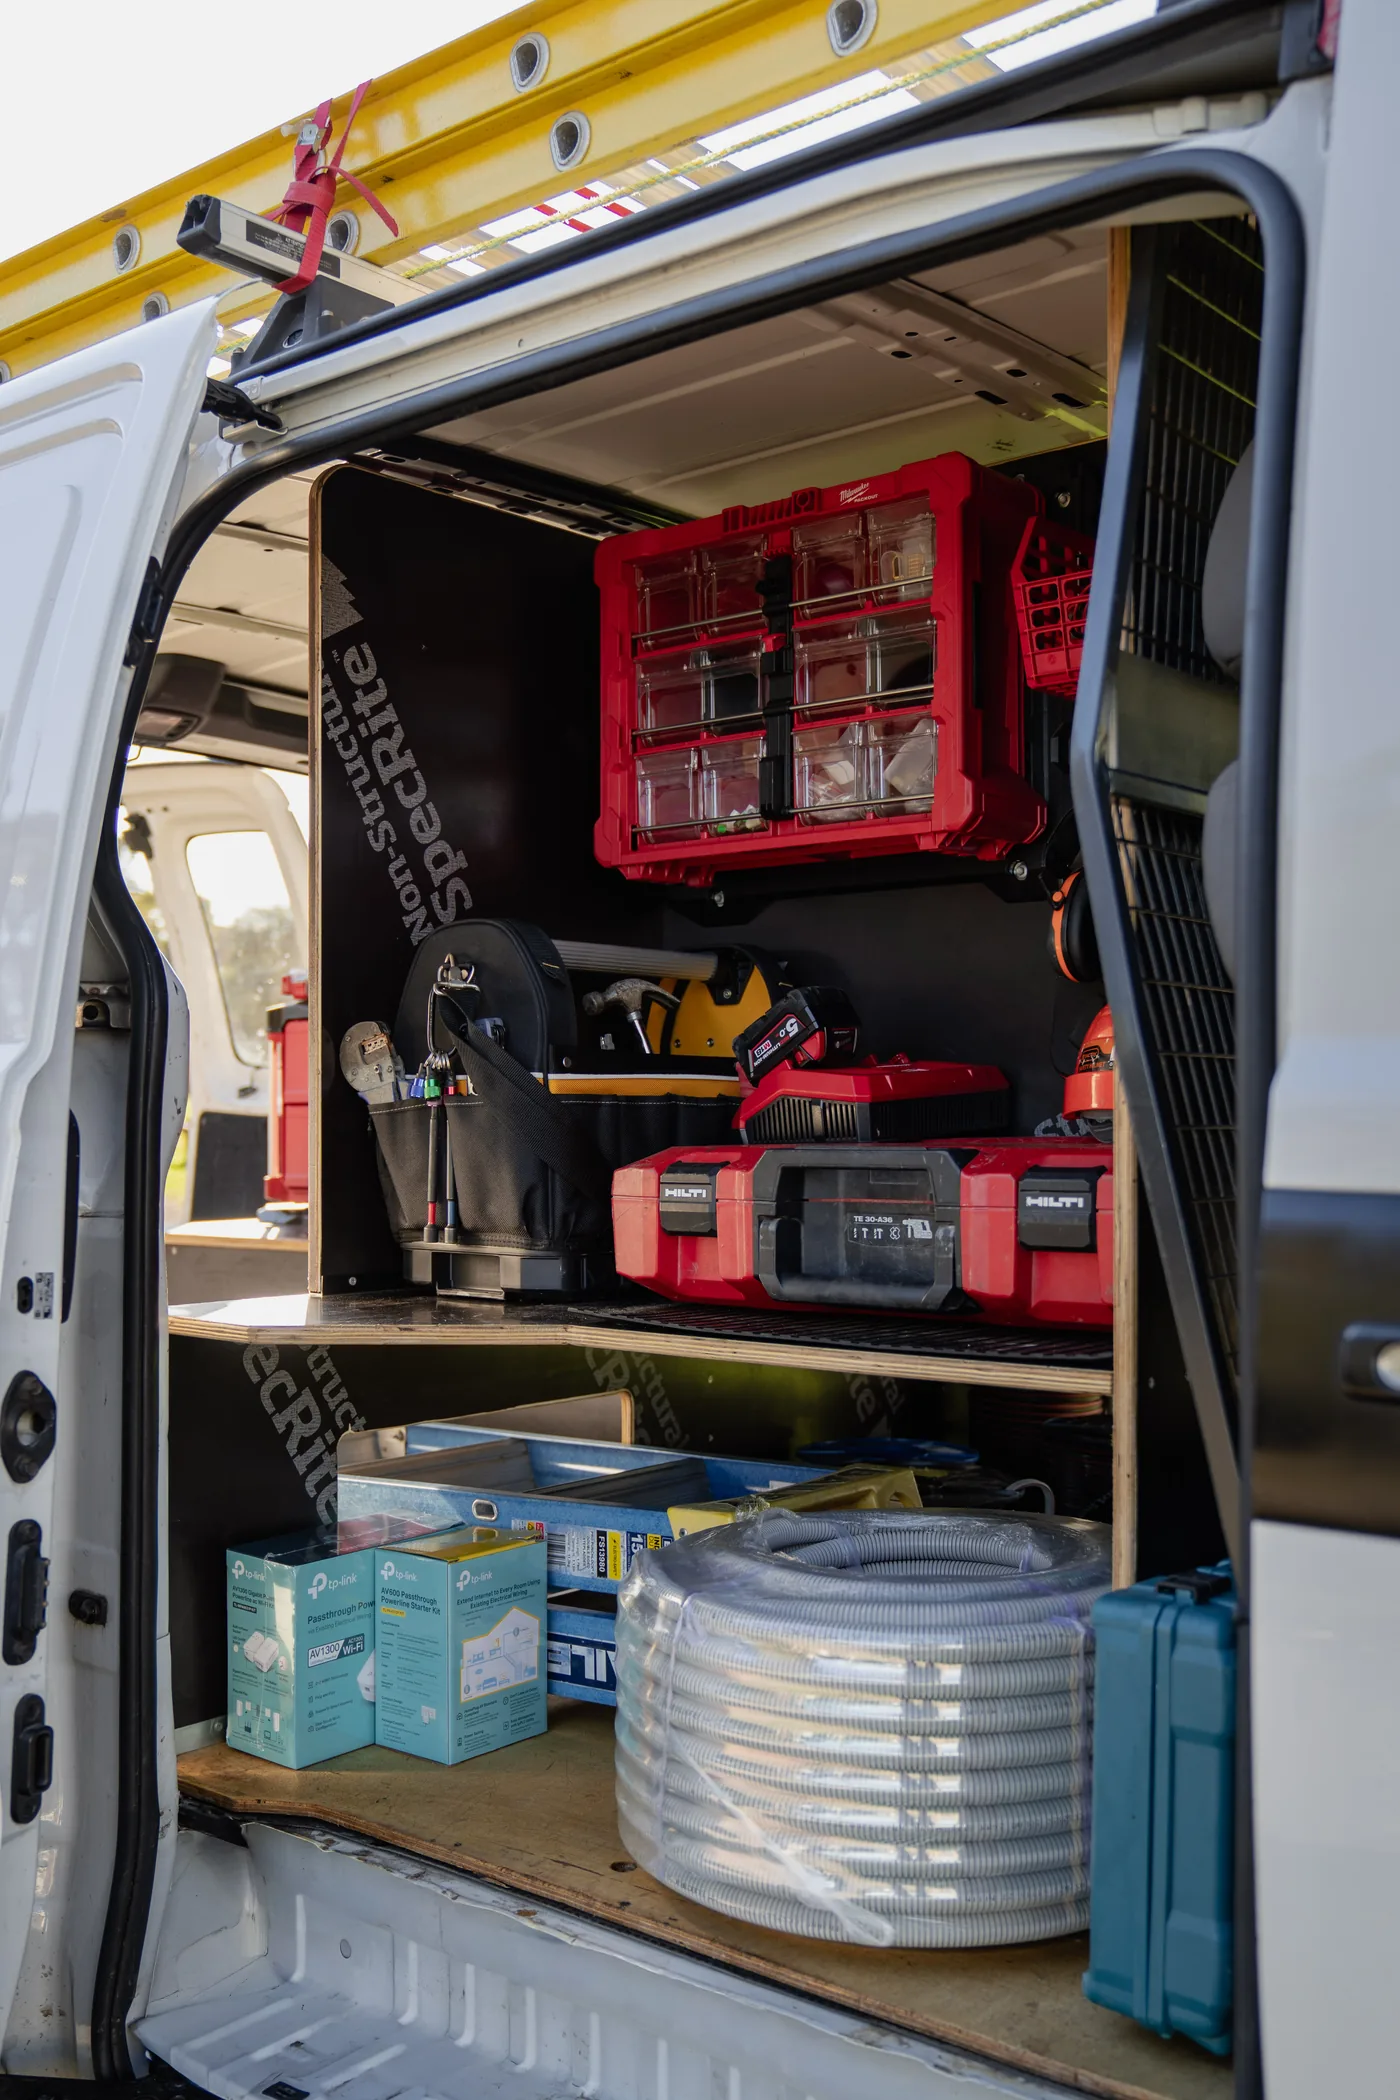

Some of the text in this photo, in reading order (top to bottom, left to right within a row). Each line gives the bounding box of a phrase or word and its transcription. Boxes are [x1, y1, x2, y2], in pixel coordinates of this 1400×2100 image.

[755, 1041, 772, 1057] M18
[664, 1188, 706, 1198] HILTI
[1026, 1196, 1084, 1208] HILTI
[598, 1536, 606, 1573] FS13980
[328, 1572, 358, 1591] tp-link
[396, 1570, 418, 1581] tp-link
[471, 1571, 492, 1584] tp-link
[381, 1587, 438, 1606] AV600 Passthrough
[457, 1595, 474, 1606] Extend
[474, 1591, 493, 1601] Internet
[500, 1586, 513, 1594] Every
[514, 1582, 526, 1590] Room
[527, 1579, 541, 1587] Using
[470, 1600, 490, 1609] Existing
[490, 1594, 512, 1604] Electrical
[512, 1589, 528, 1598] Wiring
[307, 1599, 375, 1625] Passthrough Pow
[381, 1596, 410, 1608] Powerline
[410, 1602, 431, 1613] Starter
[432, 1607, 441, 1616] Kit
[316, 1621, 334, 1633] Existing
[309, 1642, 340, 1660] AV1300
[342, 1643, 364, 1656] Wi-Fi
